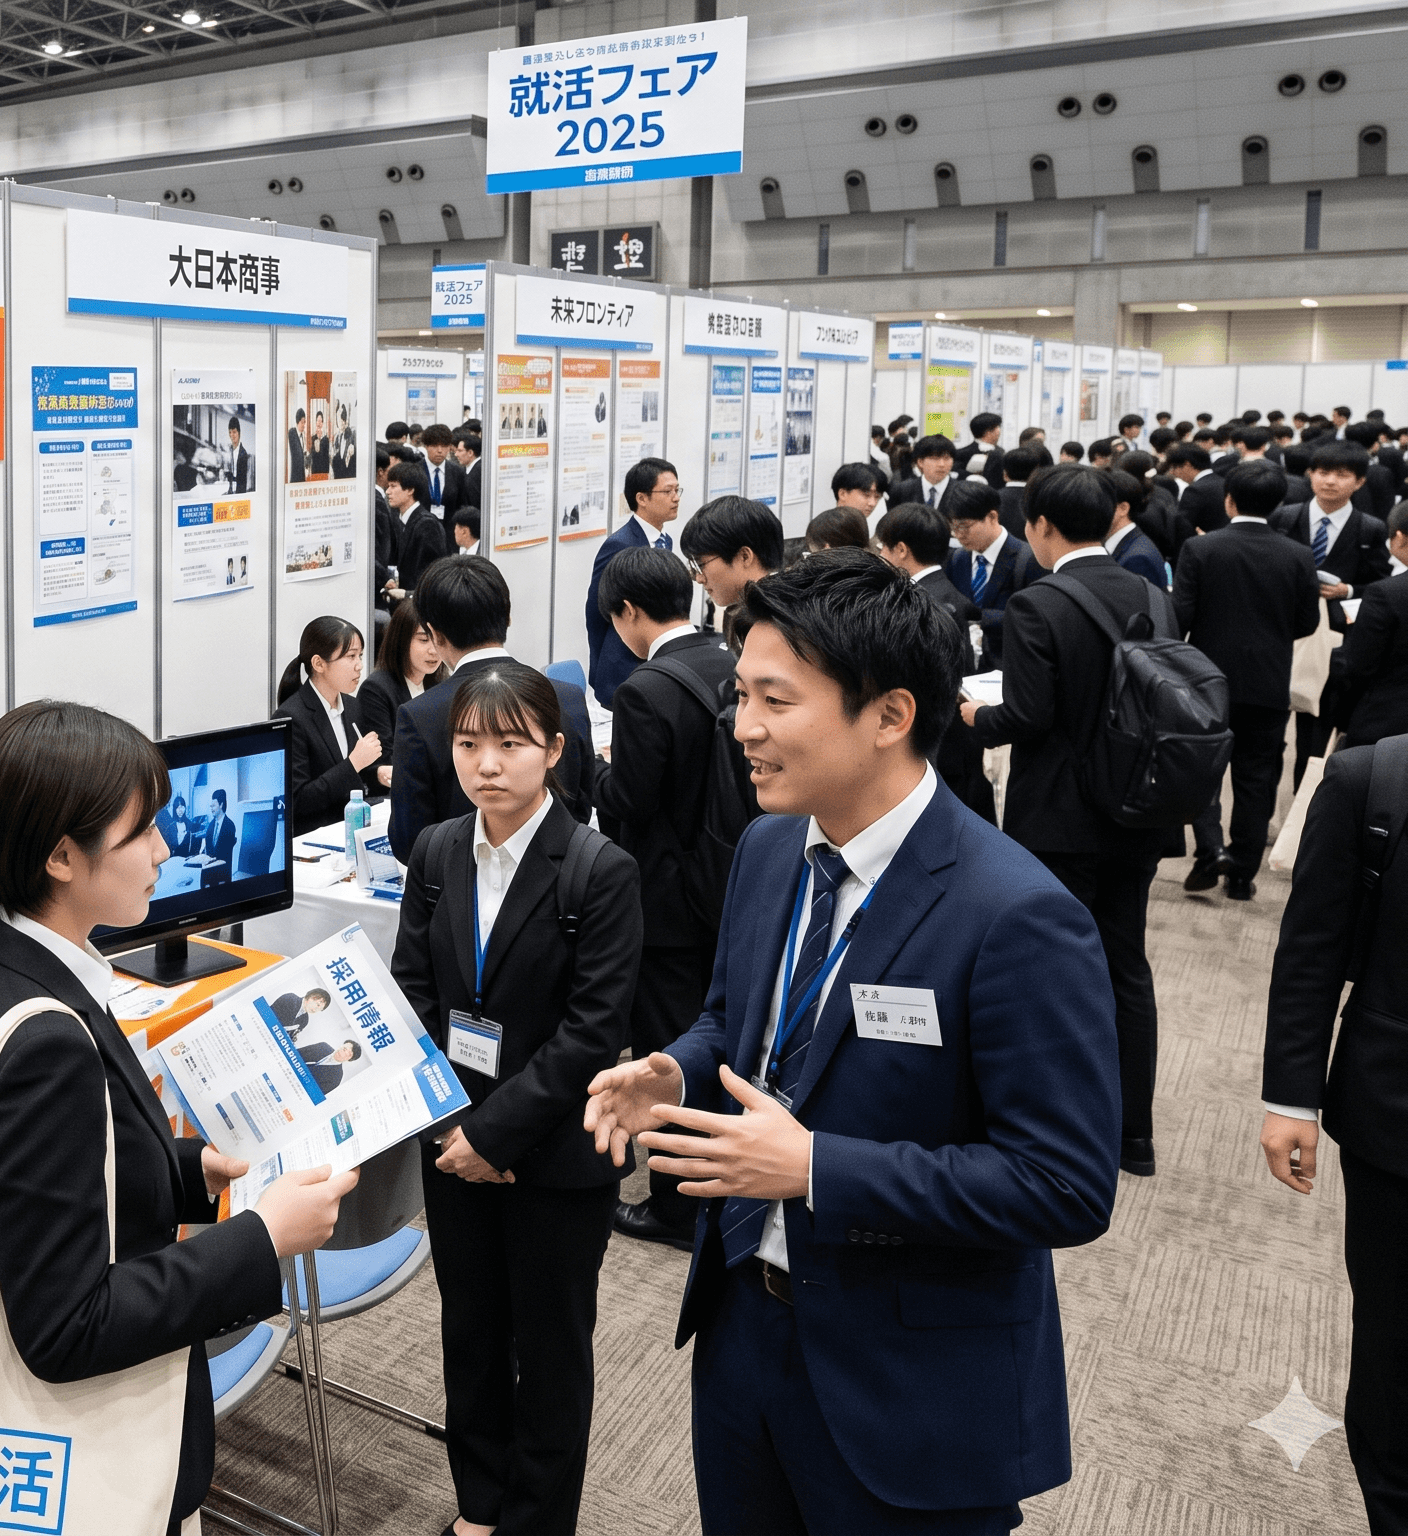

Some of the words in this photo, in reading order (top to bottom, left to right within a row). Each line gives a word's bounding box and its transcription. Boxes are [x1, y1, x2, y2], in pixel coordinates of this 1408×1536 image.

[509, 51, 718, 118] 就活フェア
[554, 110, 665, 157] 2025
[169, 244, 280, 296] 大日本商事
[444, 293, 473, 305] 2025
[550, 296, 634, 327] 未来フロンティア
[327, 957, 396, 1053] 採用情報
